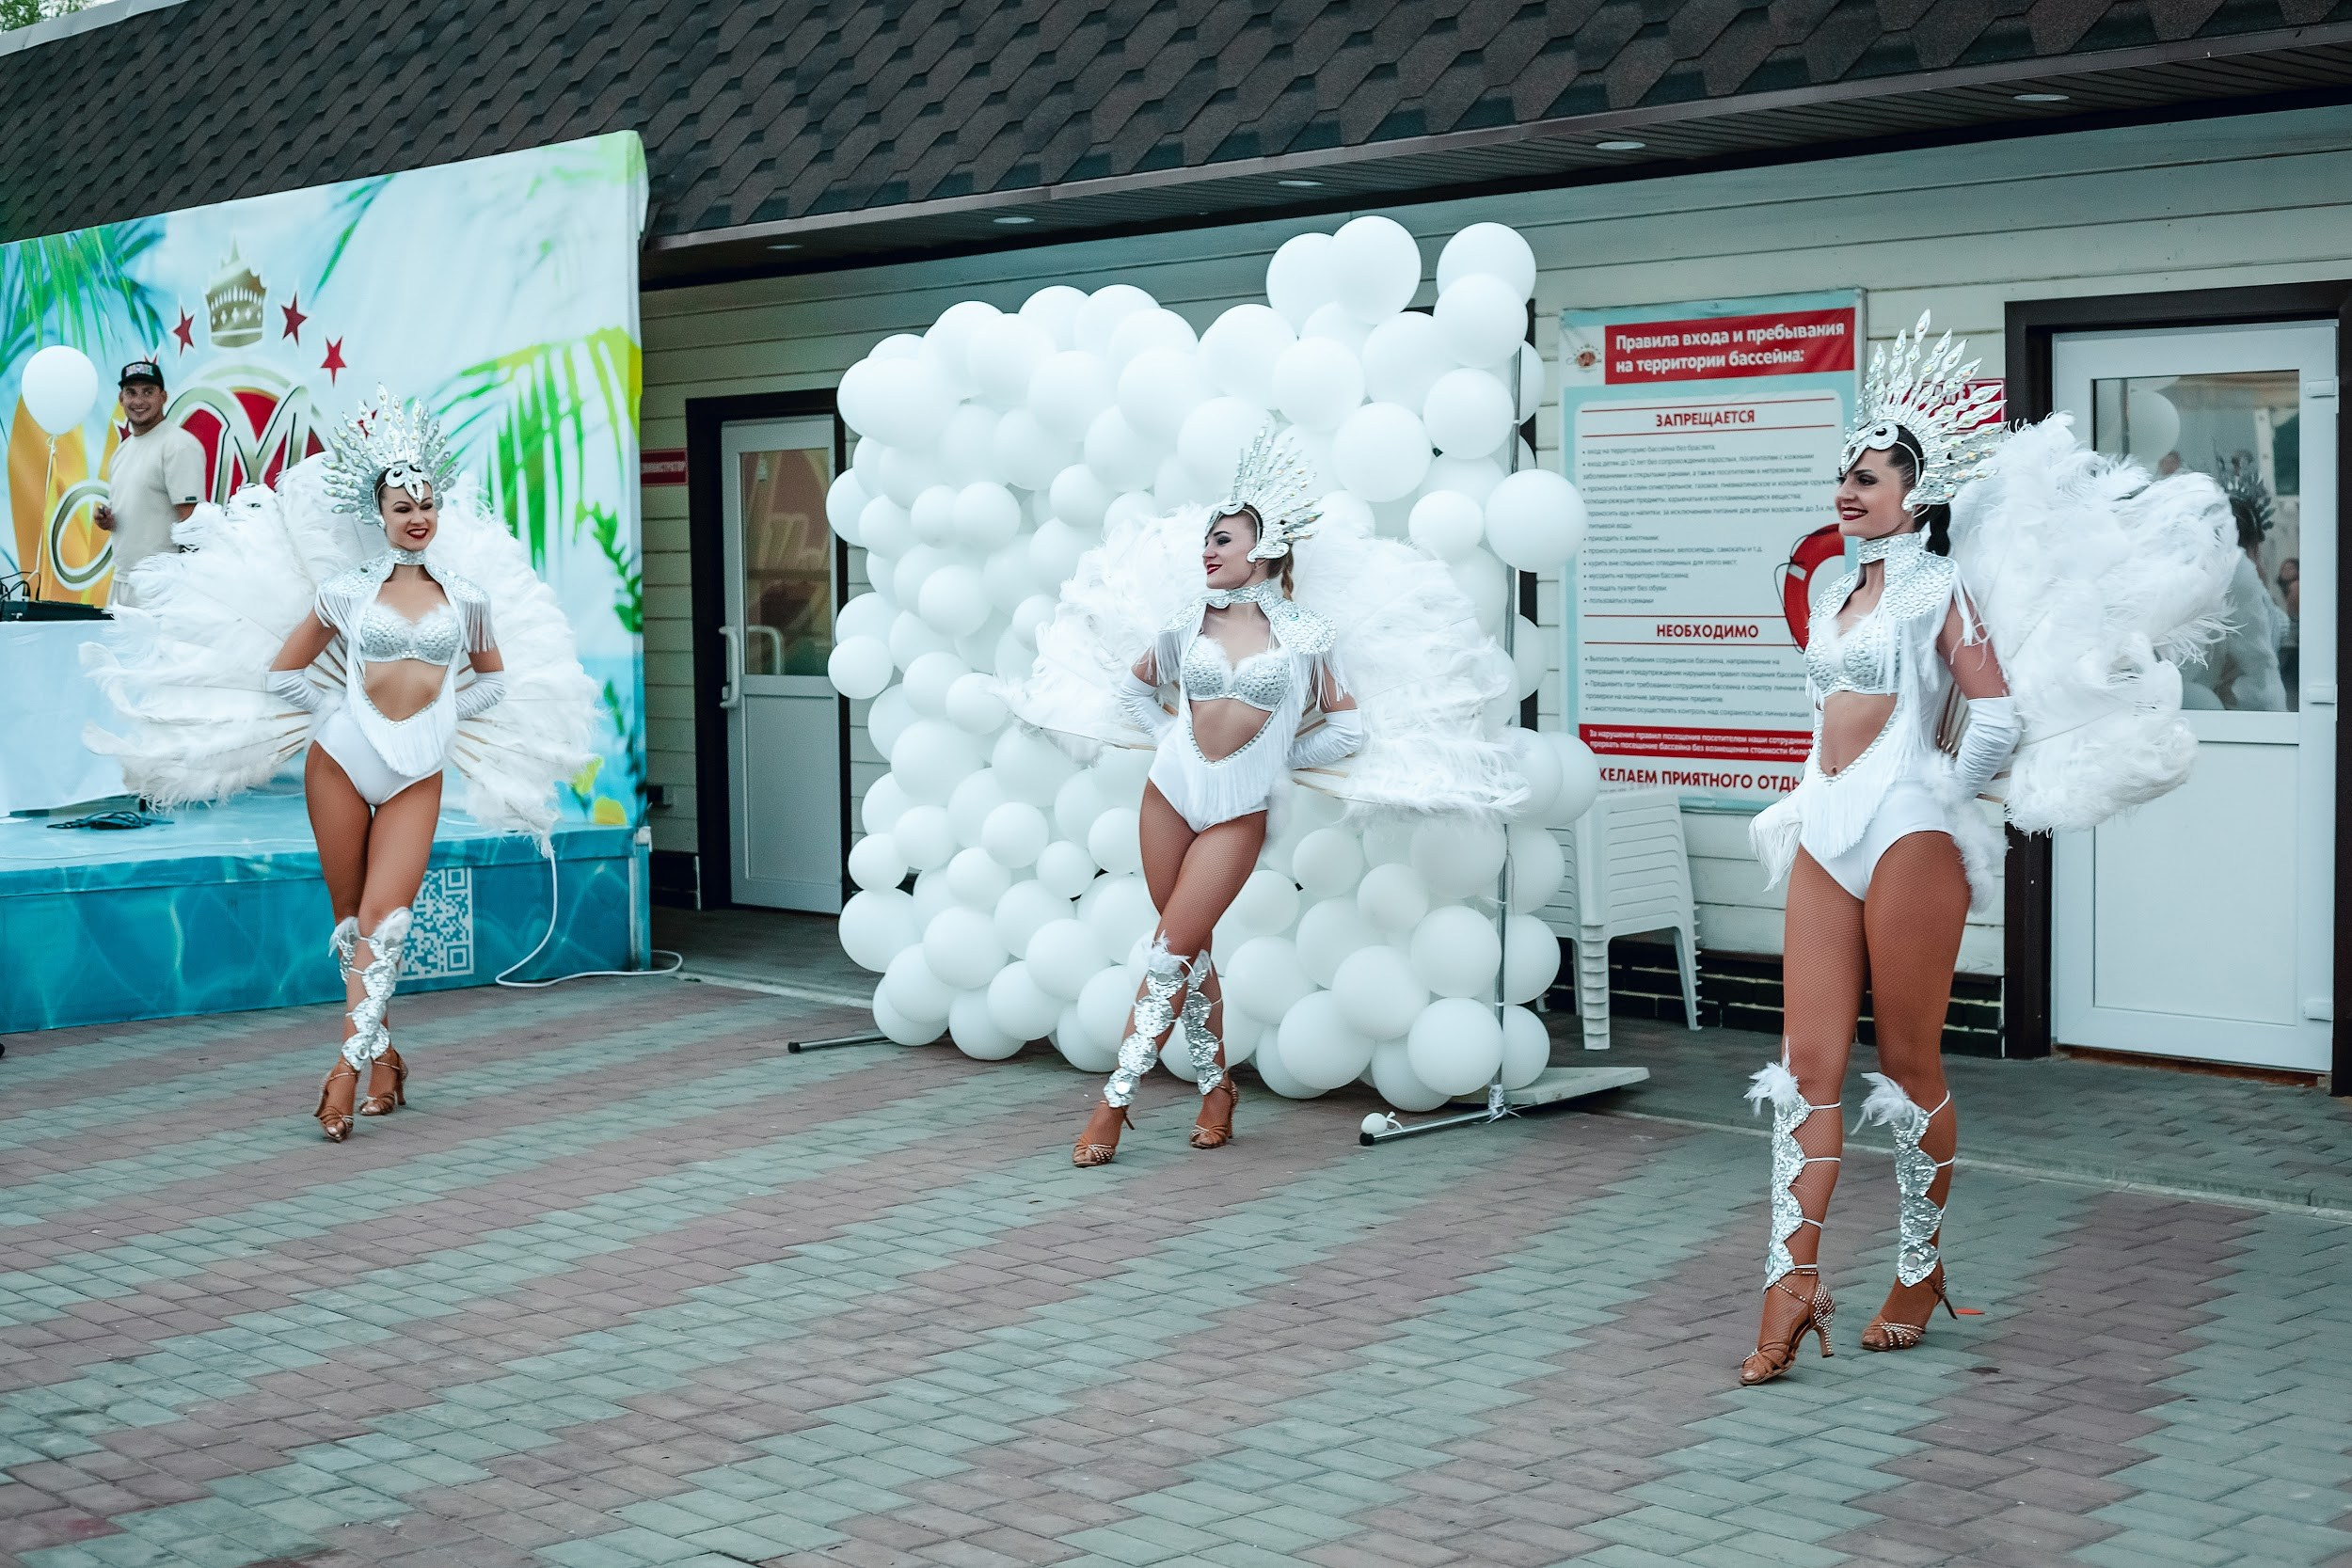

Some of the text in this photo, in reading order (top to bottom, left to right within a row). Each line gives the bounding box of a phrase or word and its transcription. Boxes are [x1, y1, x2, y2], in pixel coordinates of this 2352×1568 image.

[1615, 322, 1845, 353] Правила входа и пребывания
[1615, 348, 1805, 374] на территории бассейна:
[1656, 410, 1756, 427] ЗАПРЕЩАЕТСЯ
[1657, 625, 1759, 640] НЕОБХОДИМО
[1661, 770, 1753, 789] ПРИЯТНОГО
